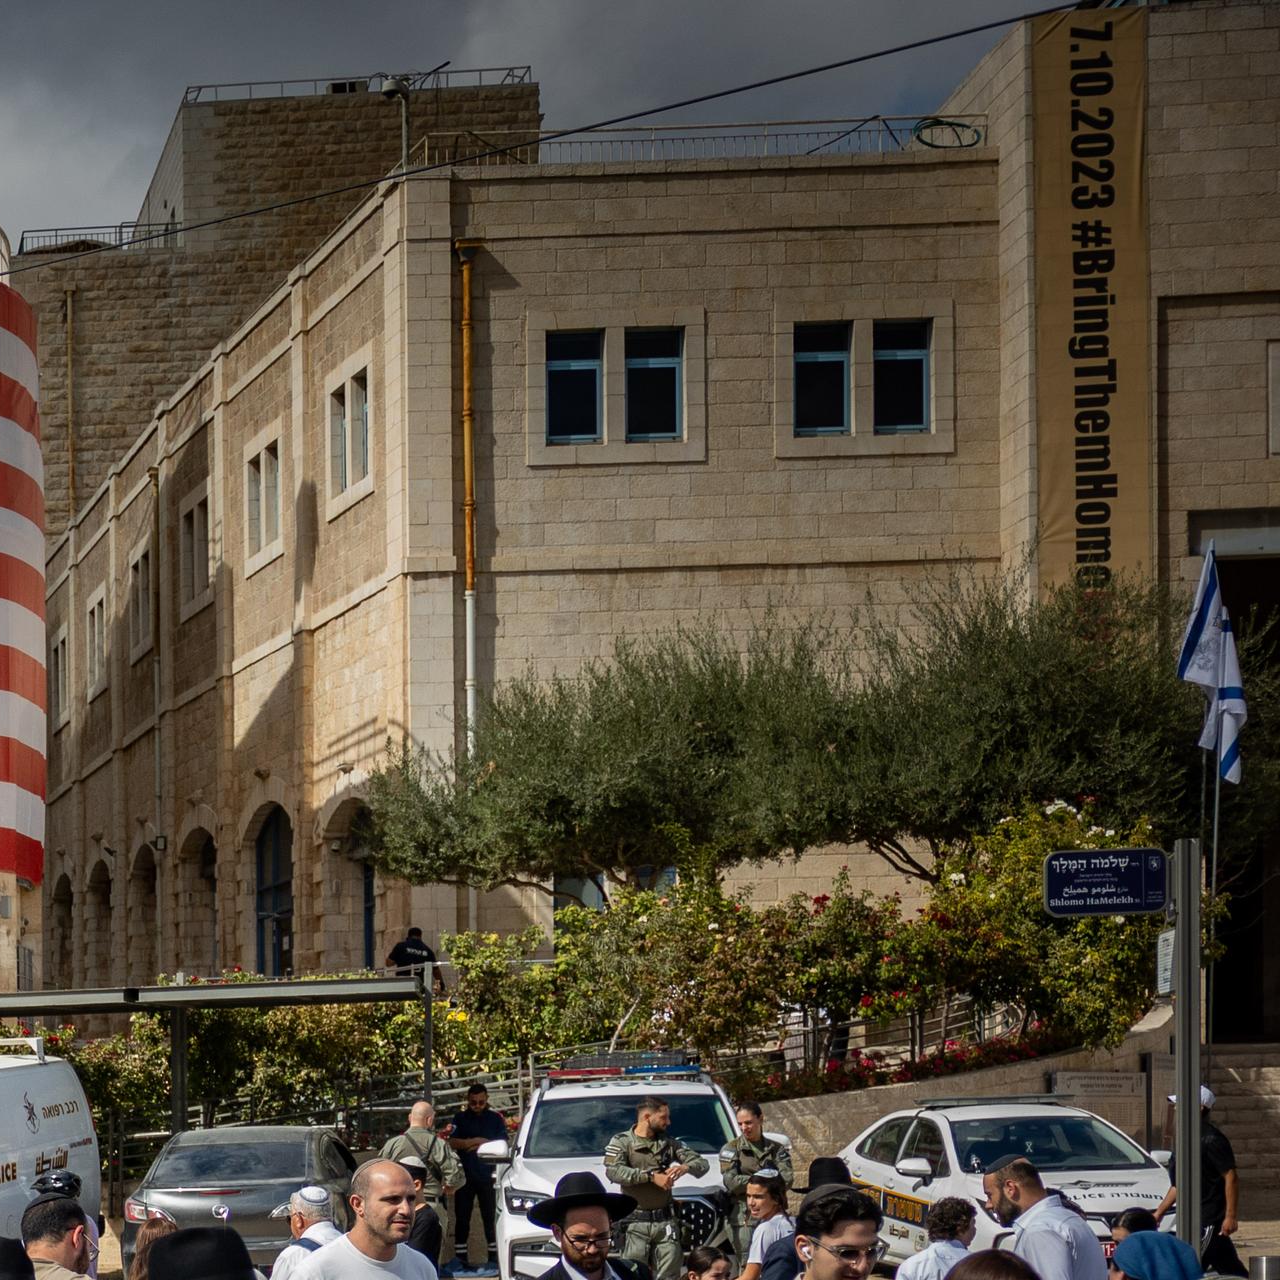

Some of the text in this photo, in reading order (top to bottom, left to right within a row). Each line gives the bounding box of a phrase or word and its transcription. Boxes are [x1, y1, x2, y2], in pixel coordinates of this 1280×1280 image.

[1069, 20, 1115, 210] 7.10.2023
[1069, 220, 1119, 589] #BringThemHome
[1050, 897, 1085, 907] Shlomo
[1086, 896, 1134, 906] HaMelekh
[41, 1100, 80, 1119] רכב רפואה
[35, 1147, 69, 1176] الشطة
[1111, 1192, 1164, 1201] משטרה
